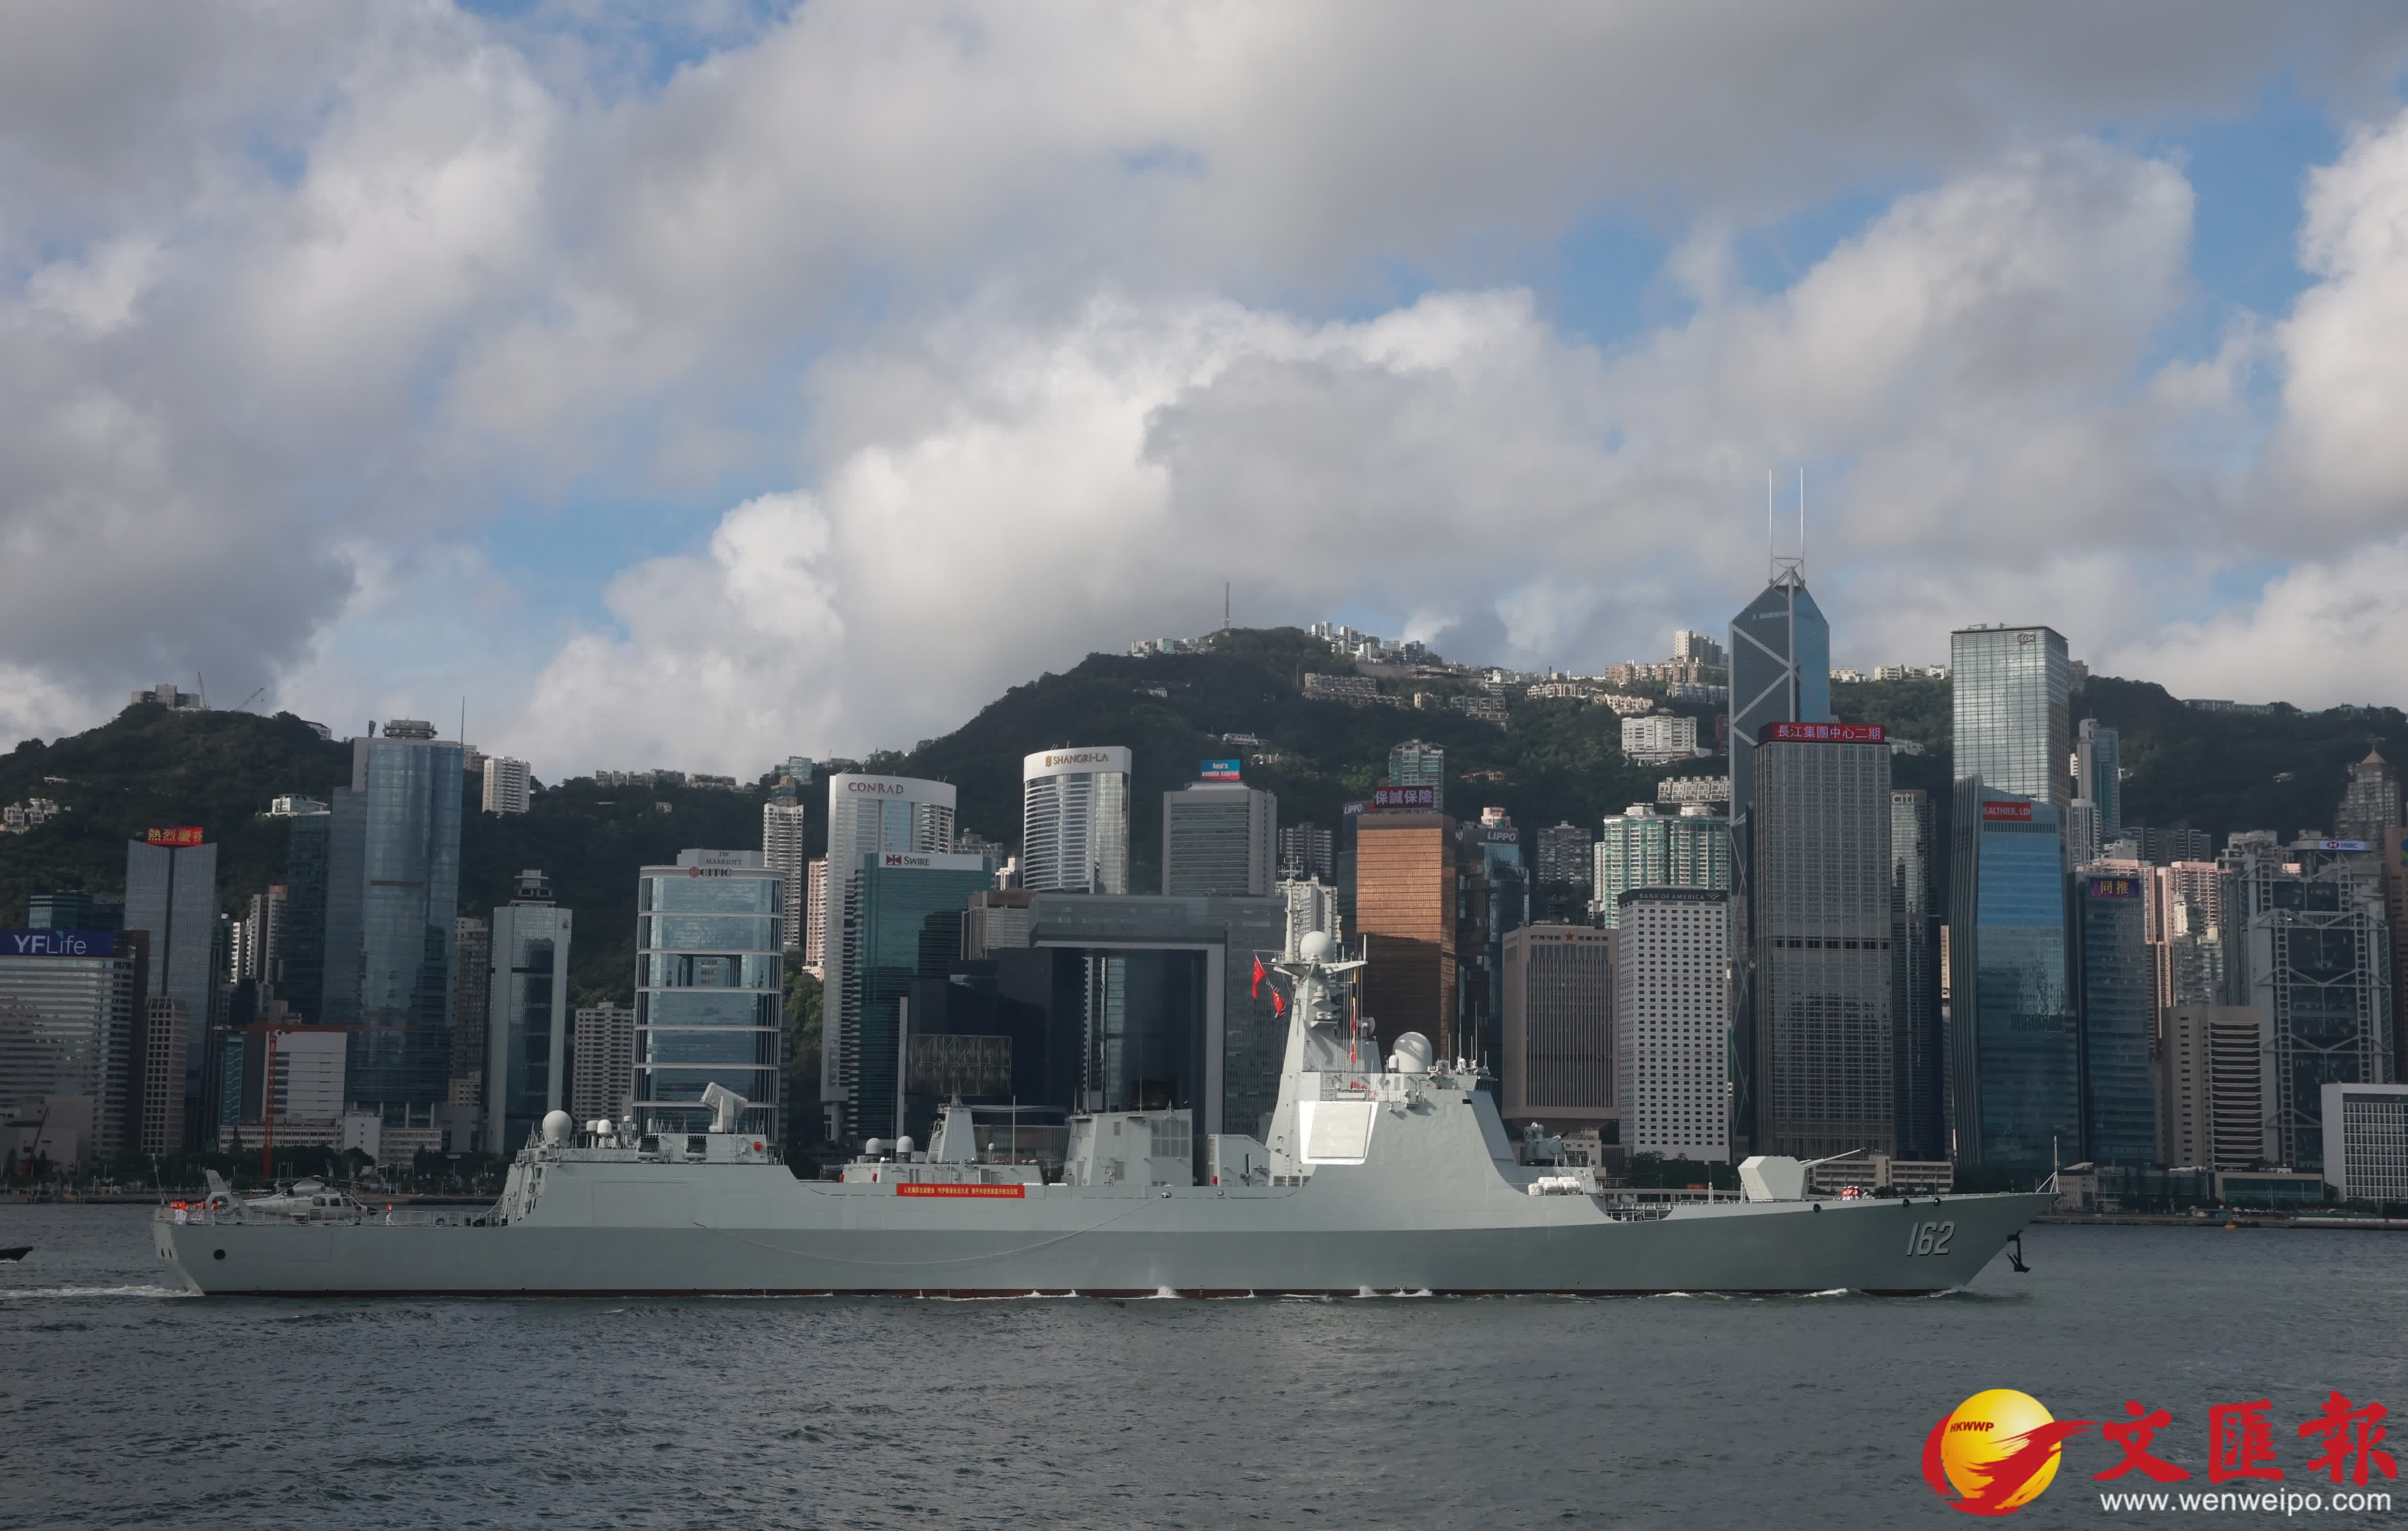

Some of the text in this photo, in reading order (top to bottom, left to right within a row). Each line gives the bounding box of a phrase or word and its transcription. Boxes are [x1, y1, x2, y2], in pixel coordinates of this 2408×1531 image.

[1778, 725, 1880, 740] 長江集團中心二期
[1053, 753, 1109, 765] SHANGRI-LA
[848, 782, 903, 794] CONRAD
[1375, 790, 1433, 805] 保誠保險
[1892, 792, 1913, 804] citi
[1344, 804, 1362, 814] LIPPO
[1487, 832, 1516, 842] LIPPO
[701, 868, 732, 877] CITIC
[14, 932, 86, 955] YFLife
[1906, 1221, 1955, 1256] 162
